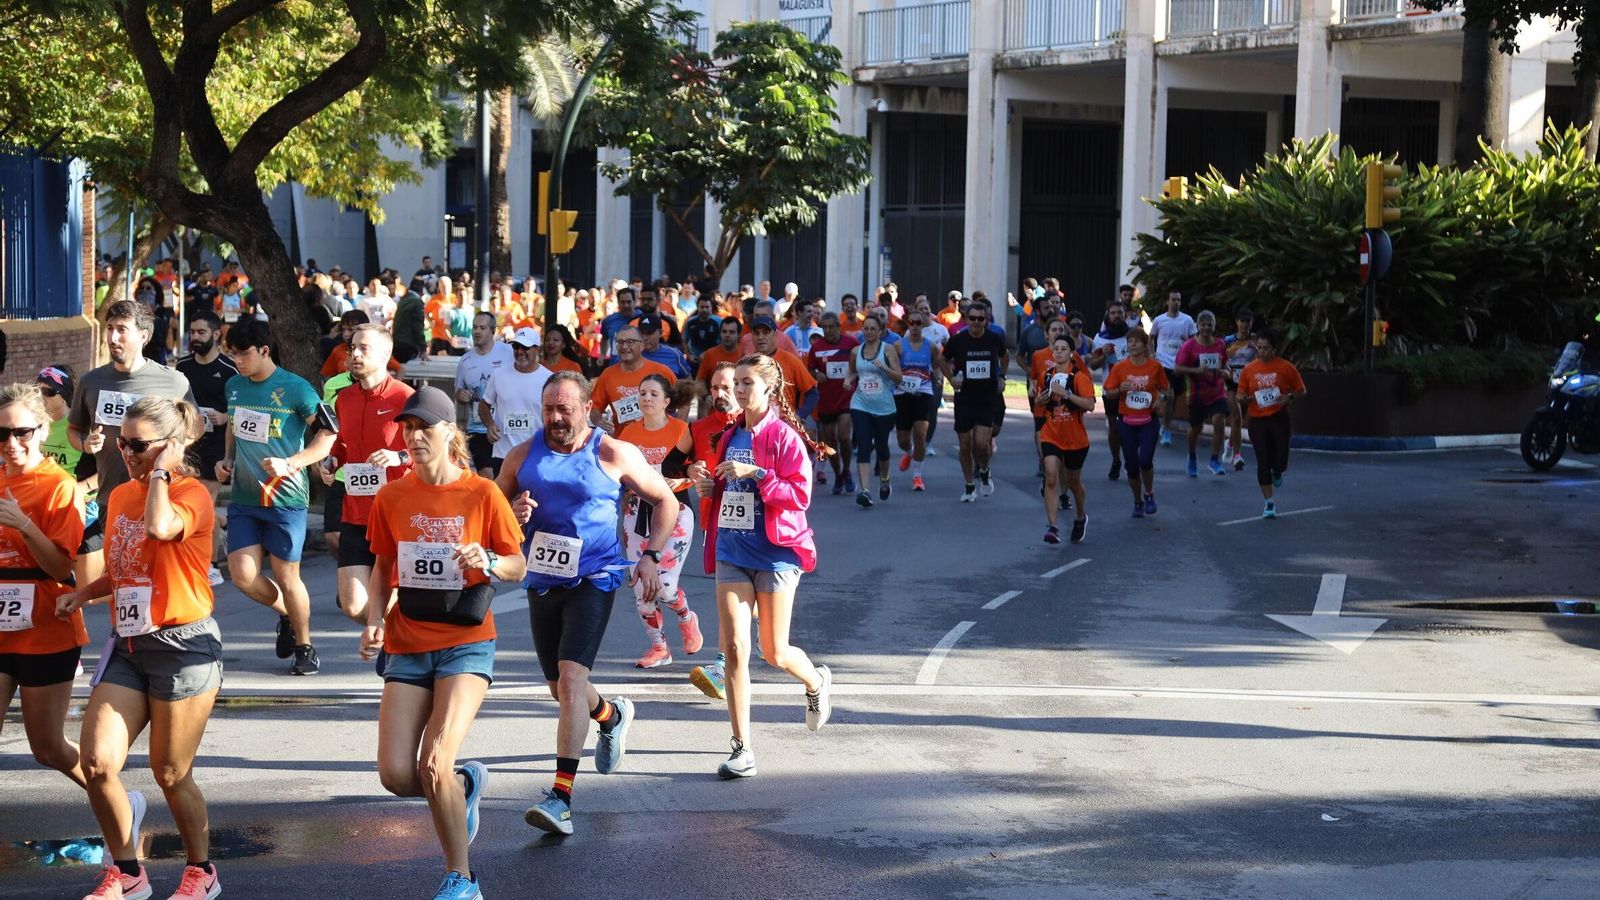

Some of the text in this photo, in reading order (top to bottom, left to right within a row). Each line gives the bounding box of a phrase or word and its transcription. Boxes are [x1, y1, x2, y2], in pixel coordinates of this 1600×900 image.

[103, 402, 131, 416] 85
[620, 402, 640, 416] 251
[240, 420, 257, 433] 42
[508, 419, 529, 428] 601
[350, 474, 379, 486] 208
[721, 504, 746, 518] 279
[535, 546, 570, 565] 370
[414, 559, 444, 576] 80
[116, 604, 140, 622] 04
